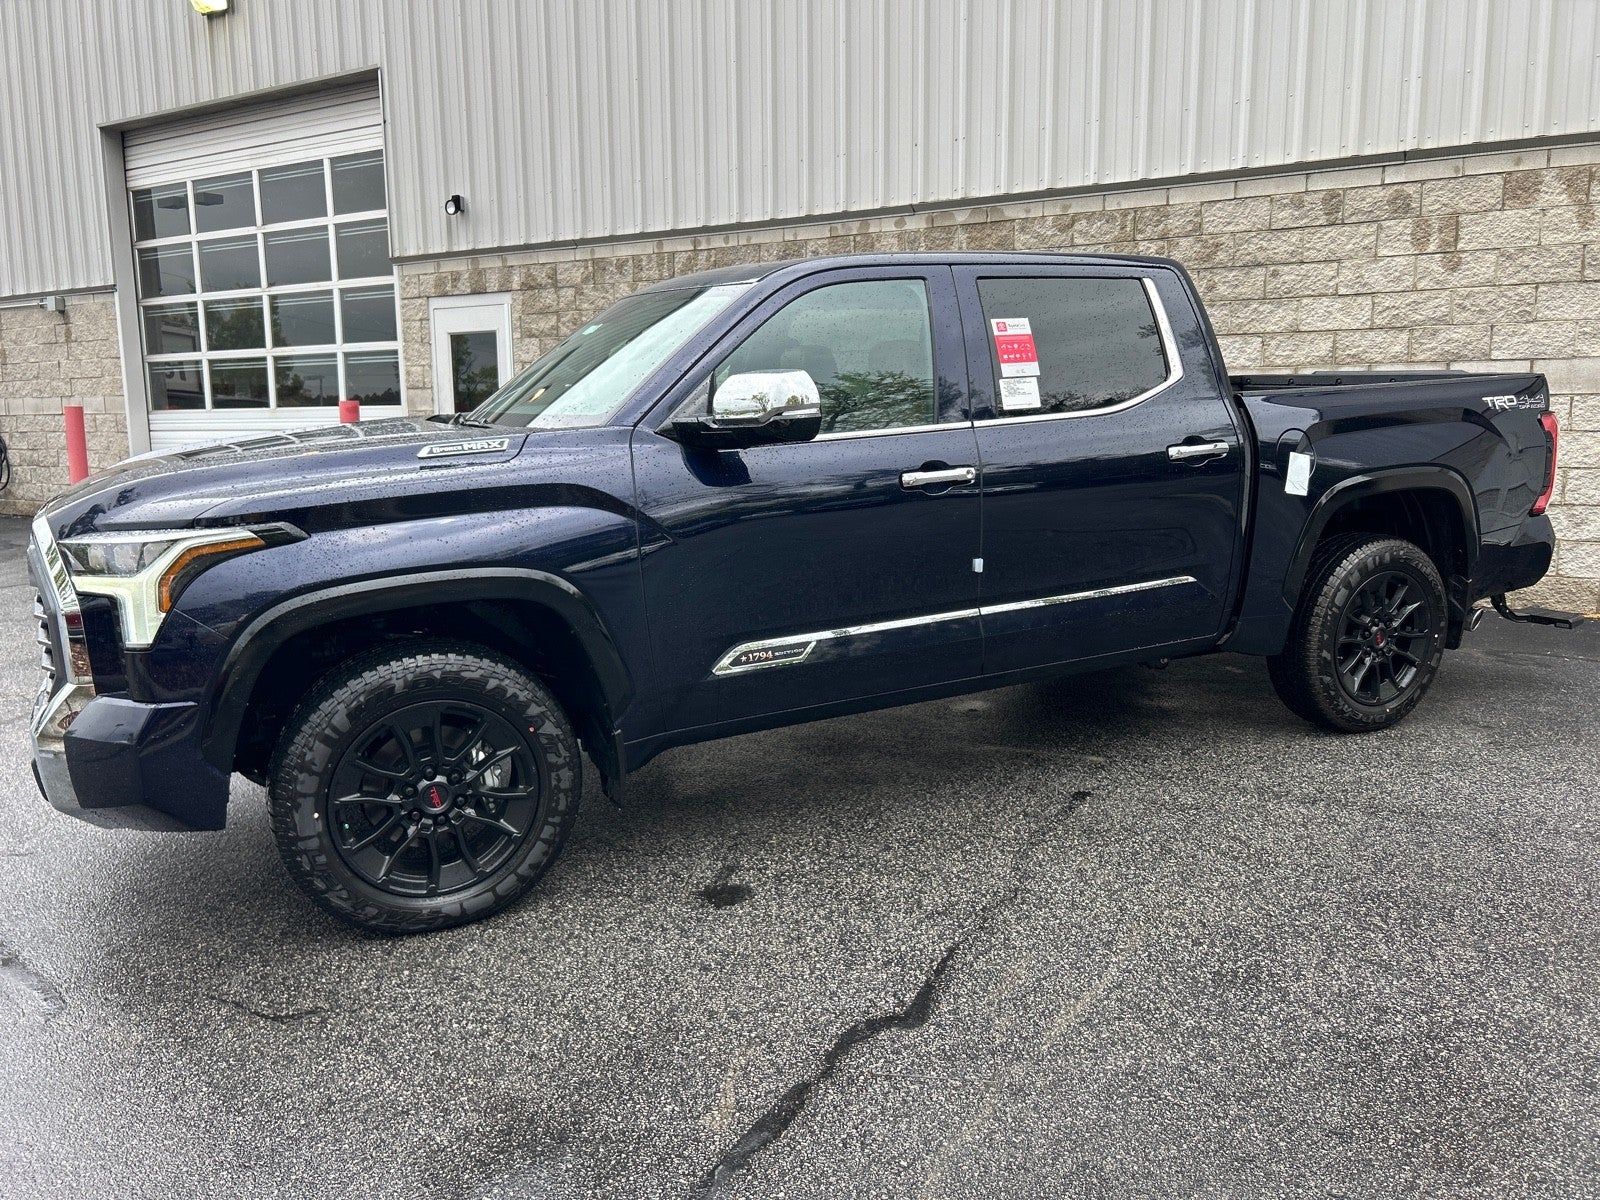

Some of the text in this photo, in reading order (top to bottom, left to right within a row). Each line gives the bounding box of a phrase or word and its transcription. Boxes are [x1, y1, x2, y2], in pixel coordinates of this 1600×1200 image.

[1481, 395, 1518, 410] TRD
[462, 440, 502, 451] MAX
[748, 650, 773, 662] 1794
[430, 786, 442, 808] TRD
